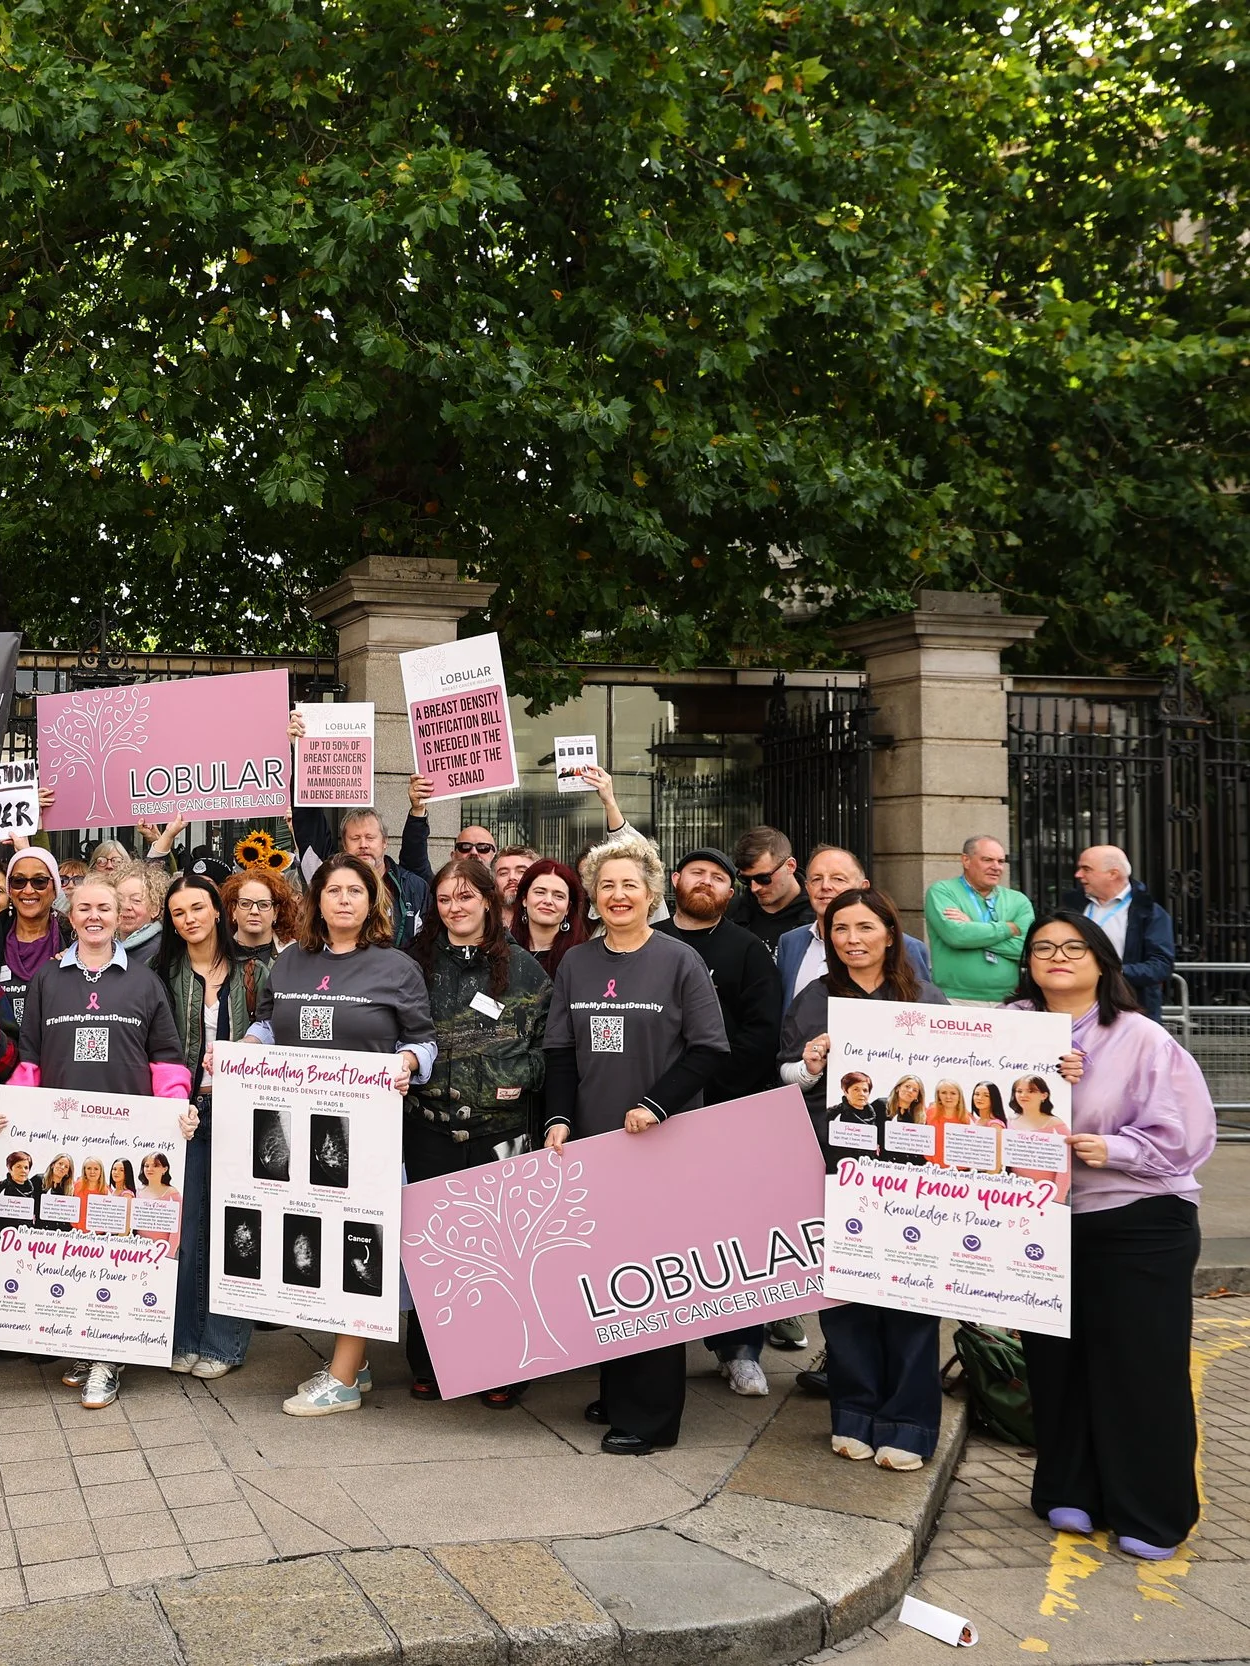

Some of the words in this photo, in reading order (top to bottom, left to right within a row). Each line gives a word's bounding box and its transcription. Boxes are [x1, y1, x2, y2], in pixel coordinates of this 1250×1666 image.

[439, 665, 491, 685] LOBULAR
[415, 707, 422, 721] A
[422, 699, 457, 719] BREAST
[459, 690, 498, 711] DENSITY
[325, 722, 366, 730] LOBULAR
[417, 713, 479, 738] NOTIFICATION
[480, 709, 501, 726] BILL
[309, 740, 319, 750] UP
[321, 740, 330, 750] TO
[332, 740, 349, 750] 50%
[350, 740, 360, 750] OF
[422, 741, 432, 755] IS
[433, 734, 469, 753] NEEDED
[470, 731, 481, 746] IN
[482, 727, 501, 744] THE
[303, 752, 331, 762] BREAST
[332, 752, 366, 762] CANCERS
[426, 752, 468, 773] LIFETIME
[469, 750, 481, 765] OF
[482, 746, 502, 762] THE
[130, 756, 285, 797] LOBULAR
[306, 777, 361, 787] MAMMOGRAMS
[447, 768, 484, 787] SEANAD
[131, 800, 176, 815] BREAST
[175, 795, 229, 812] CANCER
[230, 791, 286, 809] IRELAND
[273, 991, 373, 1004] #TellMeMyBreastDensity
[46, 1013, 142, 1027] #TellMeMyBreastDensity
[930, 1018, 992, 1033] LOBULAR
[843, 1042, 863, 1055] One
[867, 1047, 903, 1062] family,
[908, 1052, 929, 1066] four
[932, 1051, 994, 1068] generations.
[998, 1055, 1028, 1070] Same
[220, 1056, 303, 1086] Understanding
[306, 1063, 350, 1085] Breast
[348, 1066, 391, 1091] Density
[300, 1087, 327, 1095] DENSITY
[329, 1090, 369, 1099] CATEGORIES
[81, 1104, 129, 1116] LOBULAR
[838, 1158, 864, 1186] Do
[872, 1175, 907, 1197] you
[915, 1175, 969, 1199] know
[977, 1175, 1054, 1216] yours?
[361, 1208, 383, 1216] CANCER
[883, 1200, 948, 1226] Knowledge
[952, 1211, 961, 1222] is
[965, 1211, 1002, 1228] Power
[347, 1234, 372, 1243] Cancer
[581, 1220, 824, 1319] LOBULAR
[829, 1265, 880, 1280] #awareness
[891, 1272, 934, 1289] #educate
[945, 1278, 1062, 1312] #tellmemybreastdensity
[596, 1313, 670, 1345] BREAST
[674, 1290, 759, 1325] CANCER
[762, 1275, 824, 1304] IRELA
[366, 1323, 392, 1331] LOBULAR
